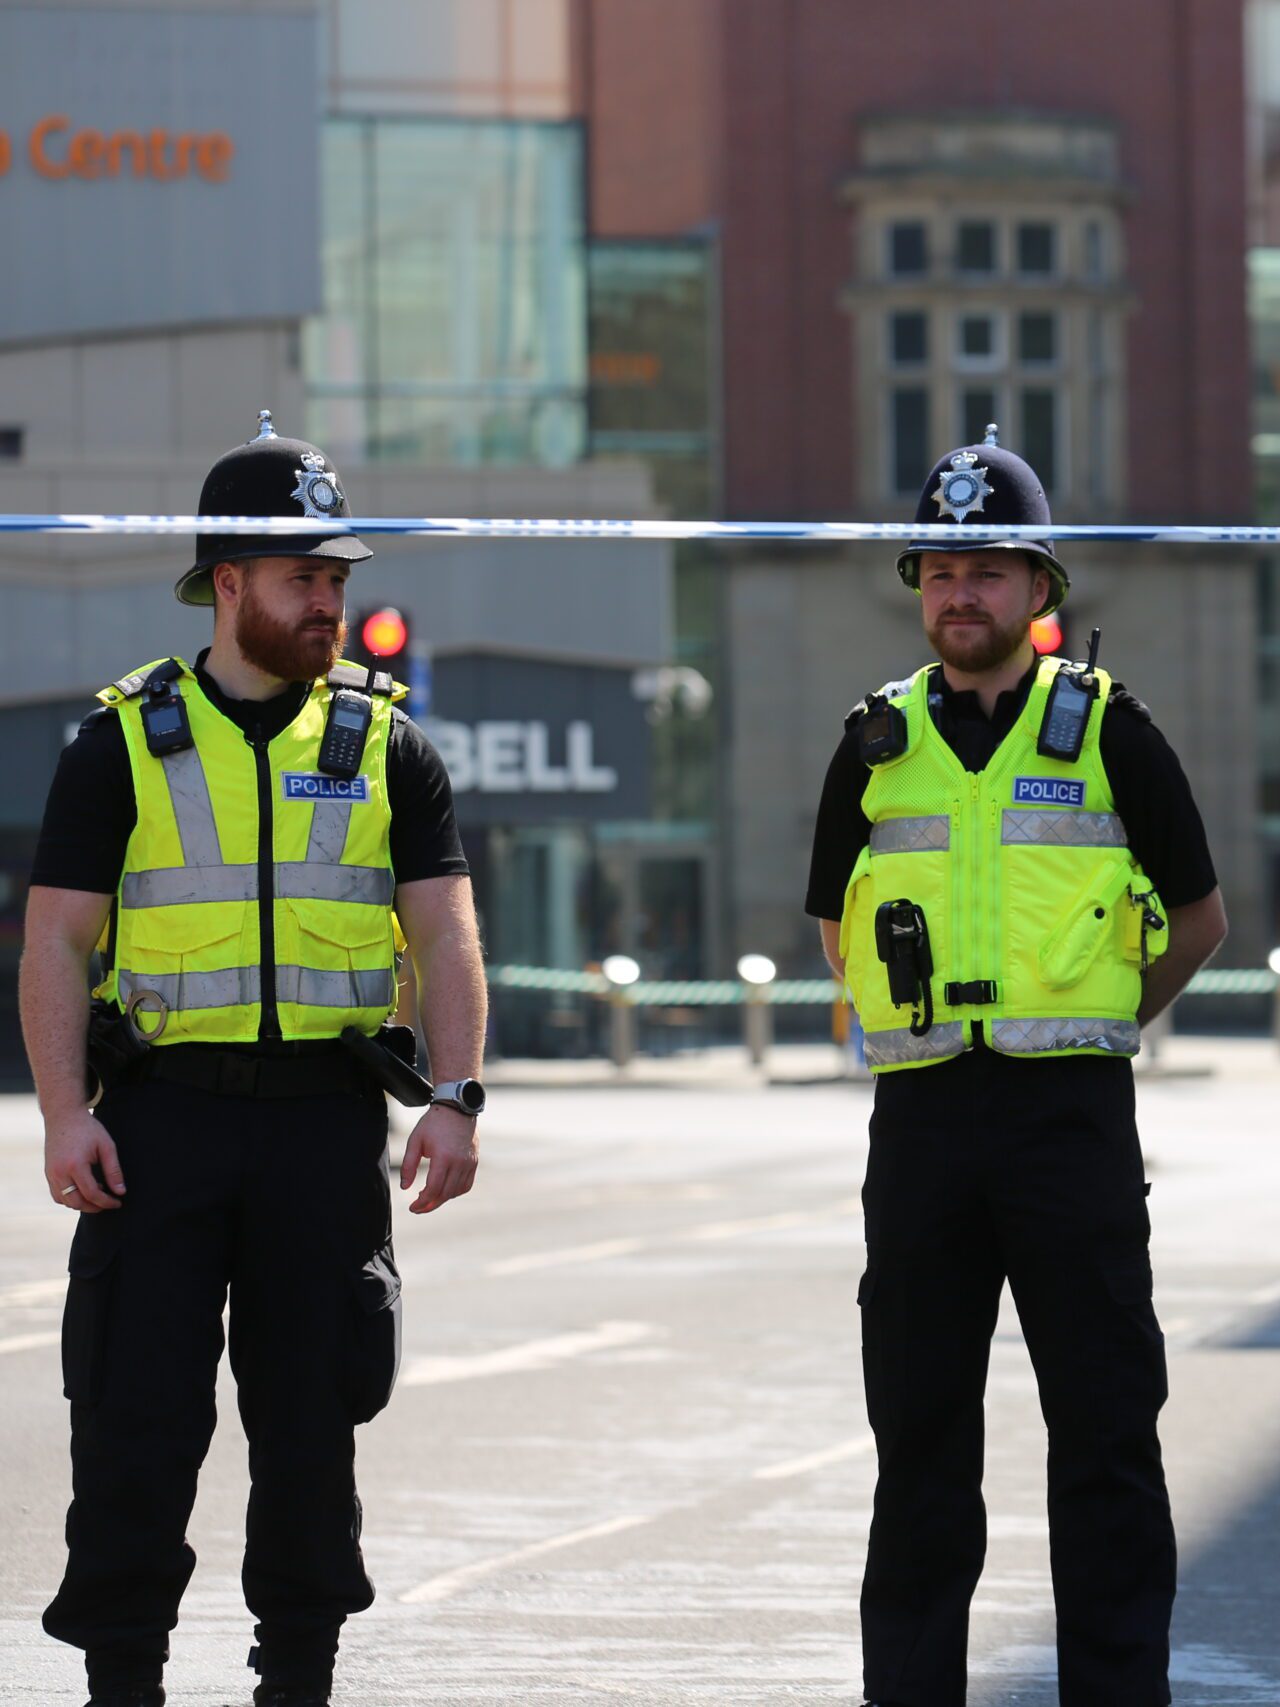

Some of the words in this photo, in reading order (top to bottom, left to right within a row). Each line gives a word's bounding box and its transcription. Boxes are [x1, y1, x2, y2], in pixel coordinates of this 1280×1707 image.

[29, 114, 235, 183] Centre
[430, 718, 618, 794] BELL
[290, 778, 363, 797] POLICE
[1018, 781, 1080, 803] POLICE
